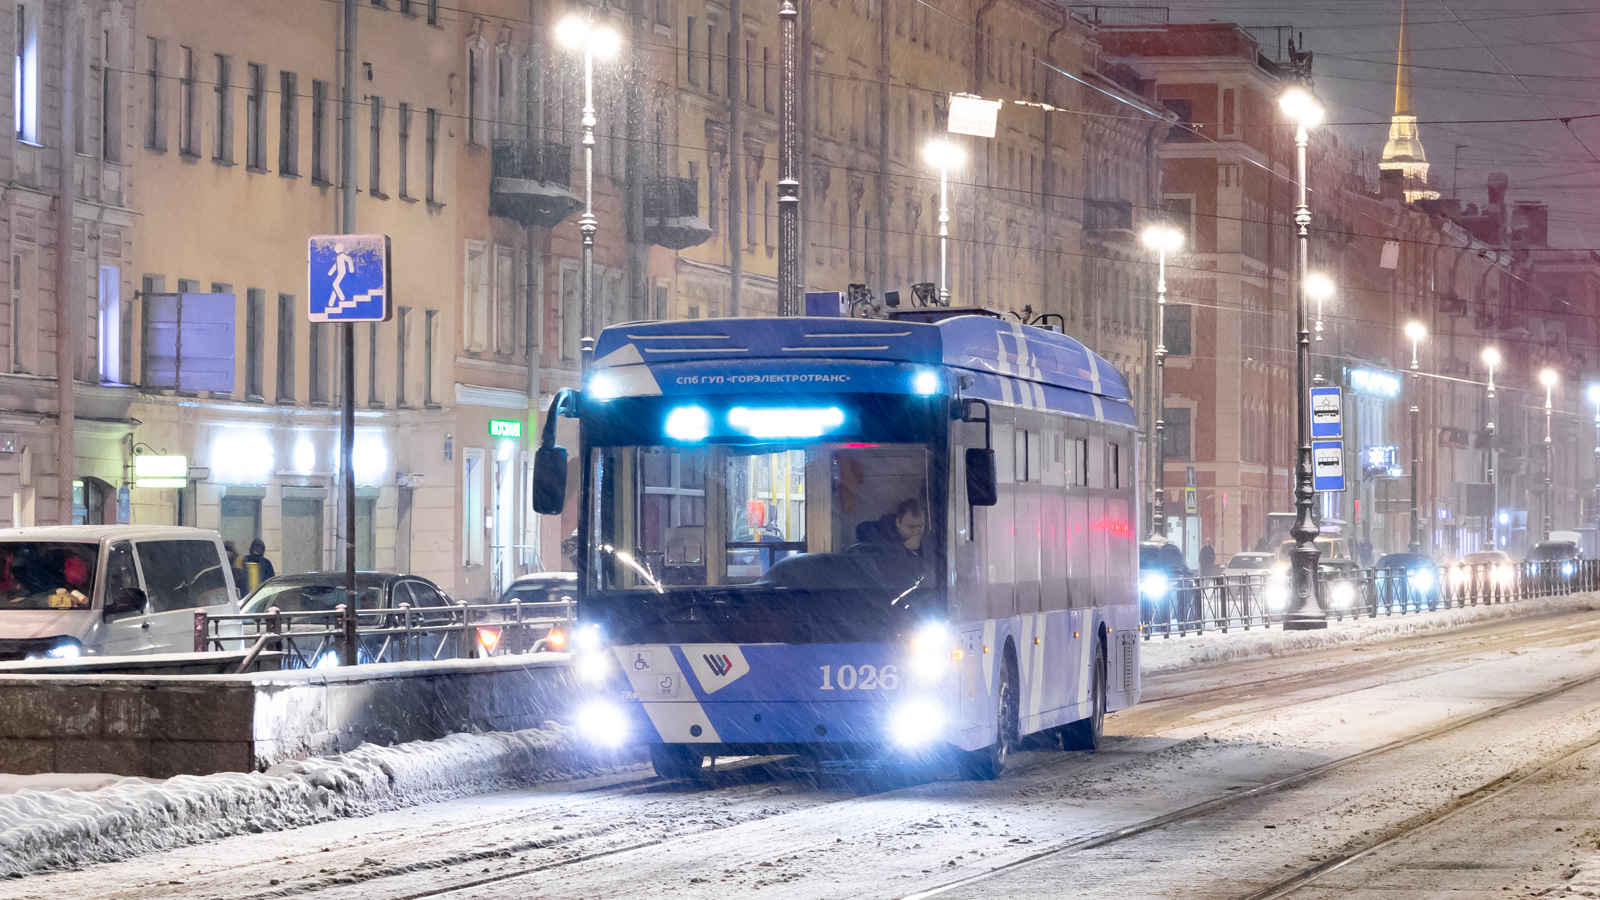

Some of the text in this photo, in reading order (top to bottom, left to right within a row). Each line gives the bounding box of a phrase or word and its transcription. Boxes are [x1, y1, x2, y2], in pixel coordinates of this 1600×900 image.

[676, 374, 851, 385] СПб ГУП «ГОРЭЛЕКТРОТРАНС»
[819, 664, 898, 691] 1026
